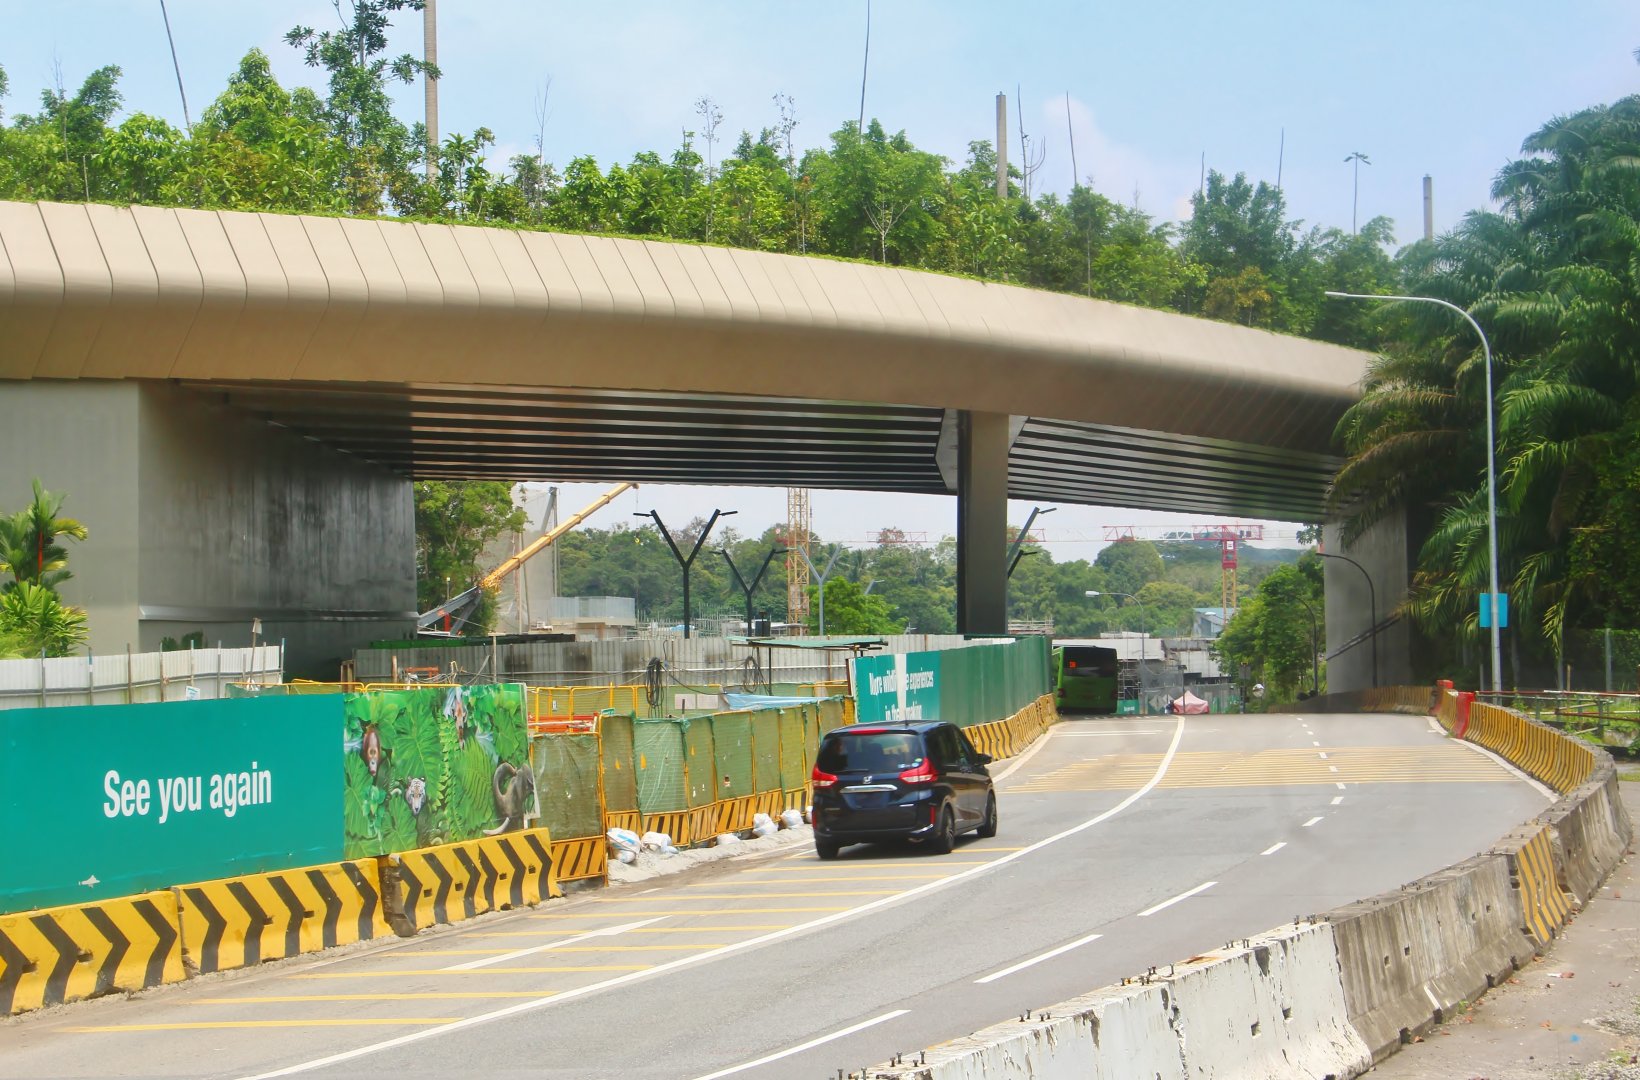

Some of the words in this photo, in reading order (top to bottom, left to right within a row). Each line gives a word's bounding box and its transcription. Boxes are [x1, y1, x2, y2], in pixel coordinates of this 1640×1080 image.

[103, 769, 150, 818] See
[158, 776, 202, 824] you
[209, 761, 272, 817] again
